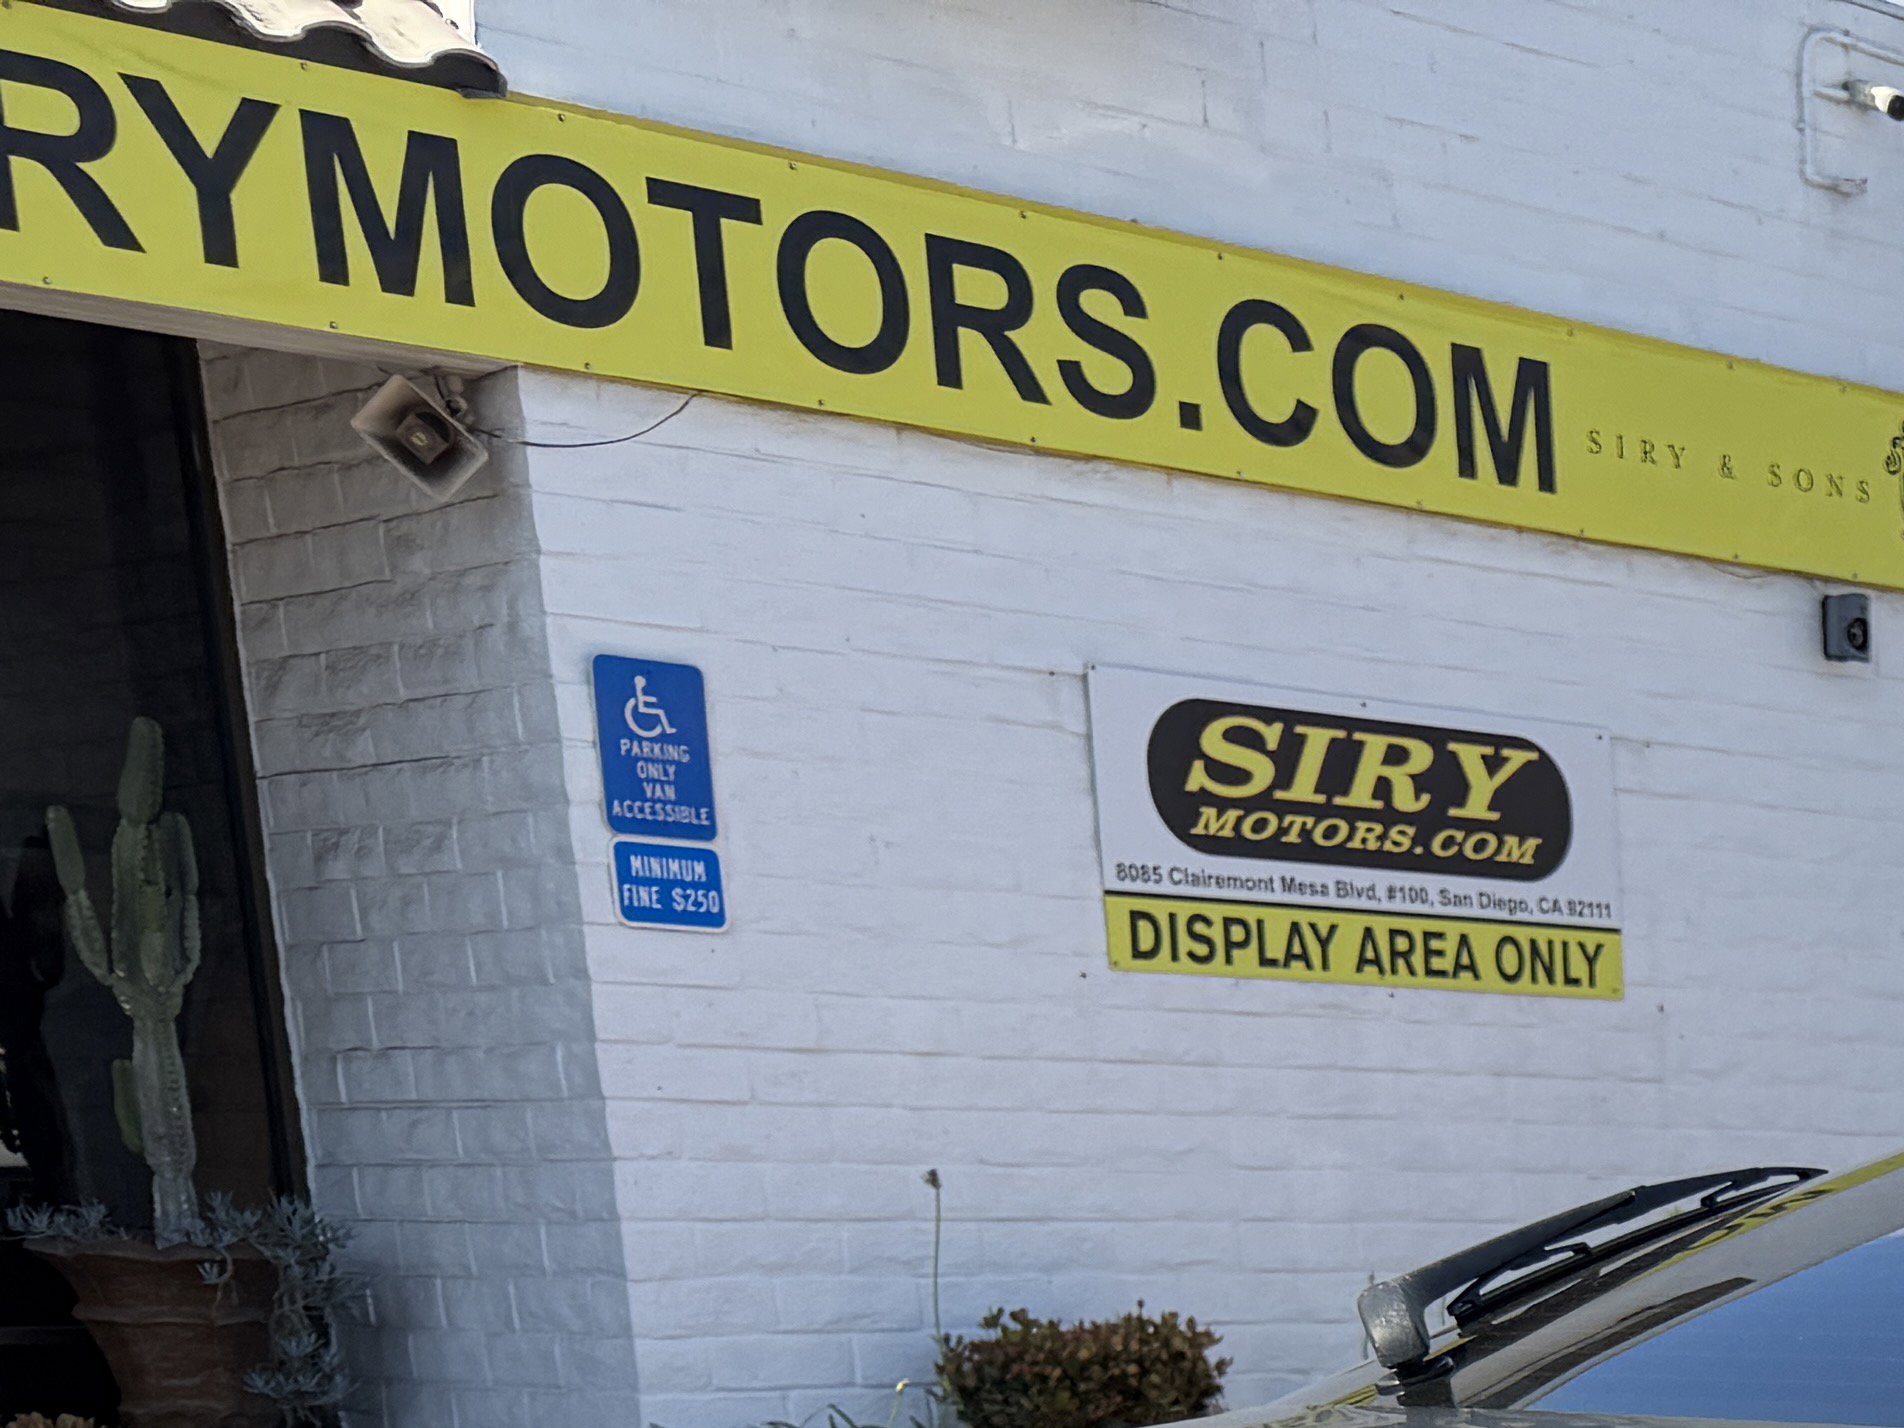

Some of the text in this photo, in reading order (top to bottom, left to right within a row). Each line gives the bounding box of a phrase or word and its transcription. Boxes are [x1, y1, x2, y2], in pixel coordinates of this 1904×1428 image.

[0, 48, 1558, 494] RYMOTORS.COM
[1586, 428, 1871, 504] SIRY & SONS
[620, 738, 690, 763] PARKING
[636, 761, 676, 781] ONLY
[1184, 714, 1541, 822] SIRY
[612, 800, 712, 825] ACCESSIBLE
[643, 782, 676, 801] VAN
[1190, 805, 1543, 865] MOTORS.COM
[630, 855, 707, 882] MINIMUM
[1116, 861, 1163, 884] 8085
[1168, 866, 1275, 894] Clairemont
[1280, 875, 1330, 897] Mesa
[1335, 879, 1382, 903] Blvd,
[1438, 888, 1474, 909] San
[1478, 891, 1534, 916] Diego,
[1537, 897, 1562, 915] CA
[622, 884, 720, 913] FINE $250
[1129, 909, 1605, 989] DISPLAY AREA ONLY
